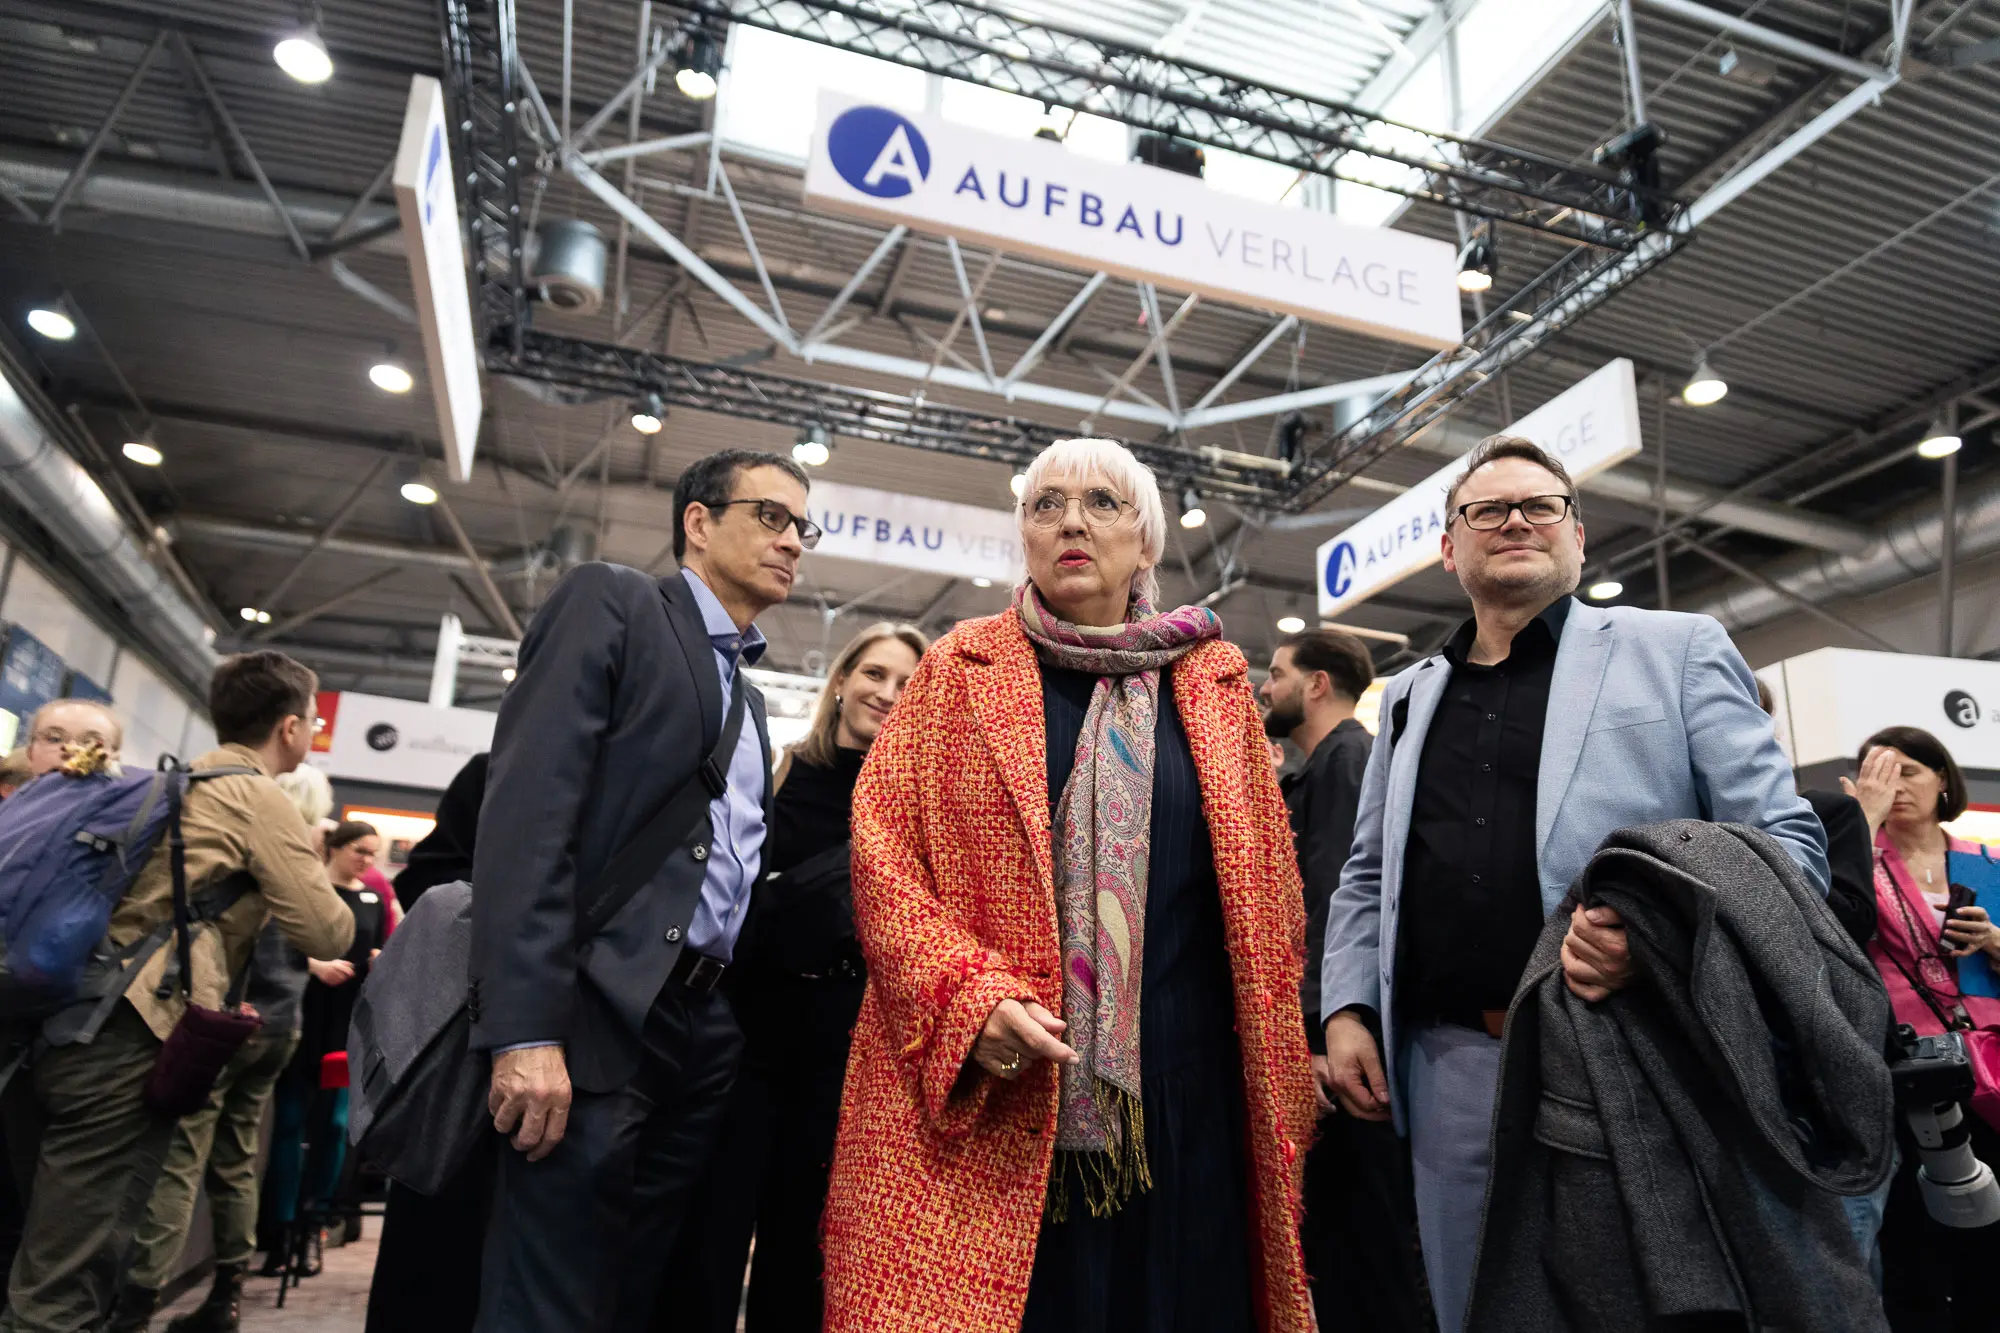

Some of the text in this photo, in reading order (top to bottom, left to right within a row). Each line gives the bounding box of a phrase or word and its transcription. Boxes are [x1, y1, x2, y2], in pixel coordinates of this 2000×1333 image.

[955, 163, 1183, 246] AUFBAU
[1206, 221, 1421, 305] VERLAGE
[807, 510, 943, 550] UFBAU
[1365, 509, 1440, 568] AUFBA
